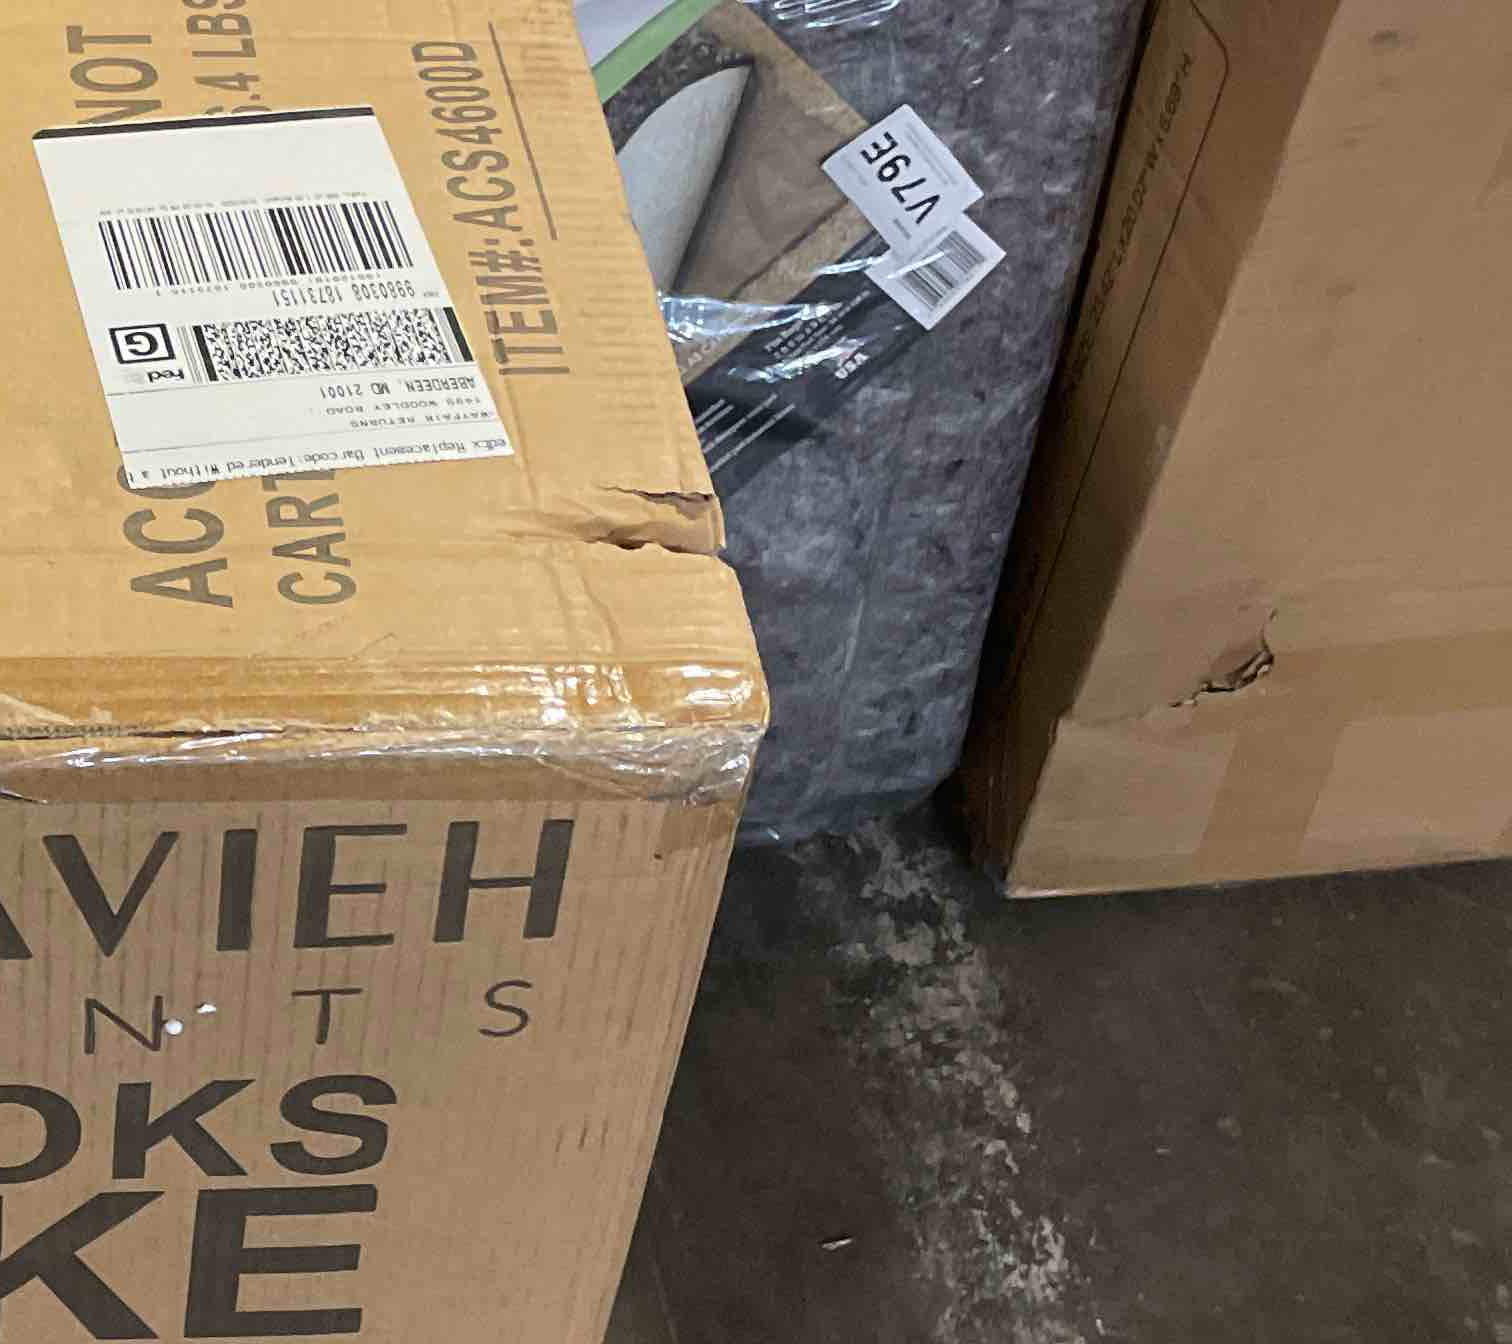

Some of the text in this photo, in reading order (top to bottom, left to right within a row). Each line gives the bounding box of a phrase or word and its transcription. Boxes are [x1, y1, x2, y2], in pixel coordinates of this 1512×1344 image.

[859, 131, 941, 225] V79E
[123, 331, 159, 357] G
[319, 383, 364, 400] 21001
[370, 382, 392, 395] MD
